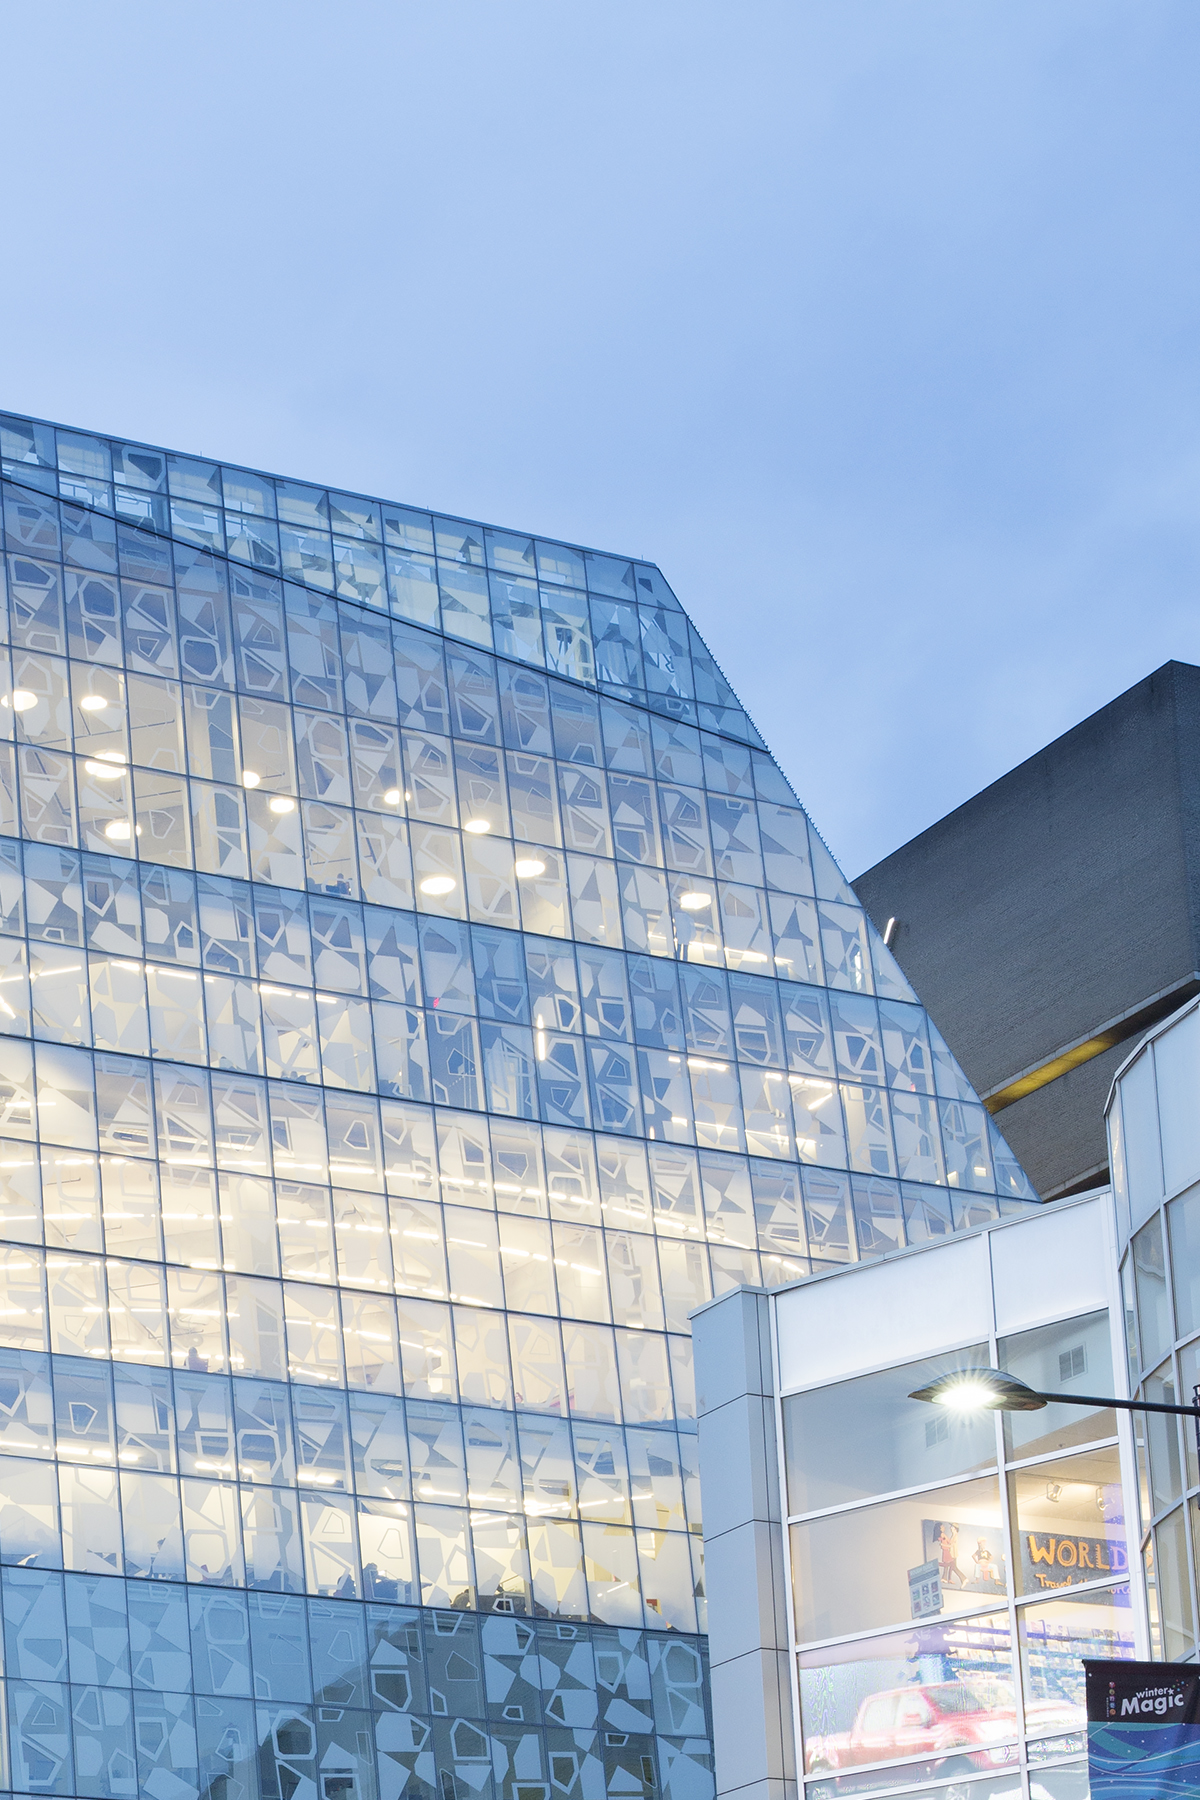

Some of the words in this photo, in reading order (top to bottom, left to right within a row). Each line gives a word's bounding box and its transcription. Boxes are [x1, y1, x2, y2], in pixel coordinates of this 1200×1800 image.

[1027, 1533, 1128, 1570] WORLD
[1136, 1688, 1168, 1698] winter
[1121, 1694, 1184, 1715] Magic
